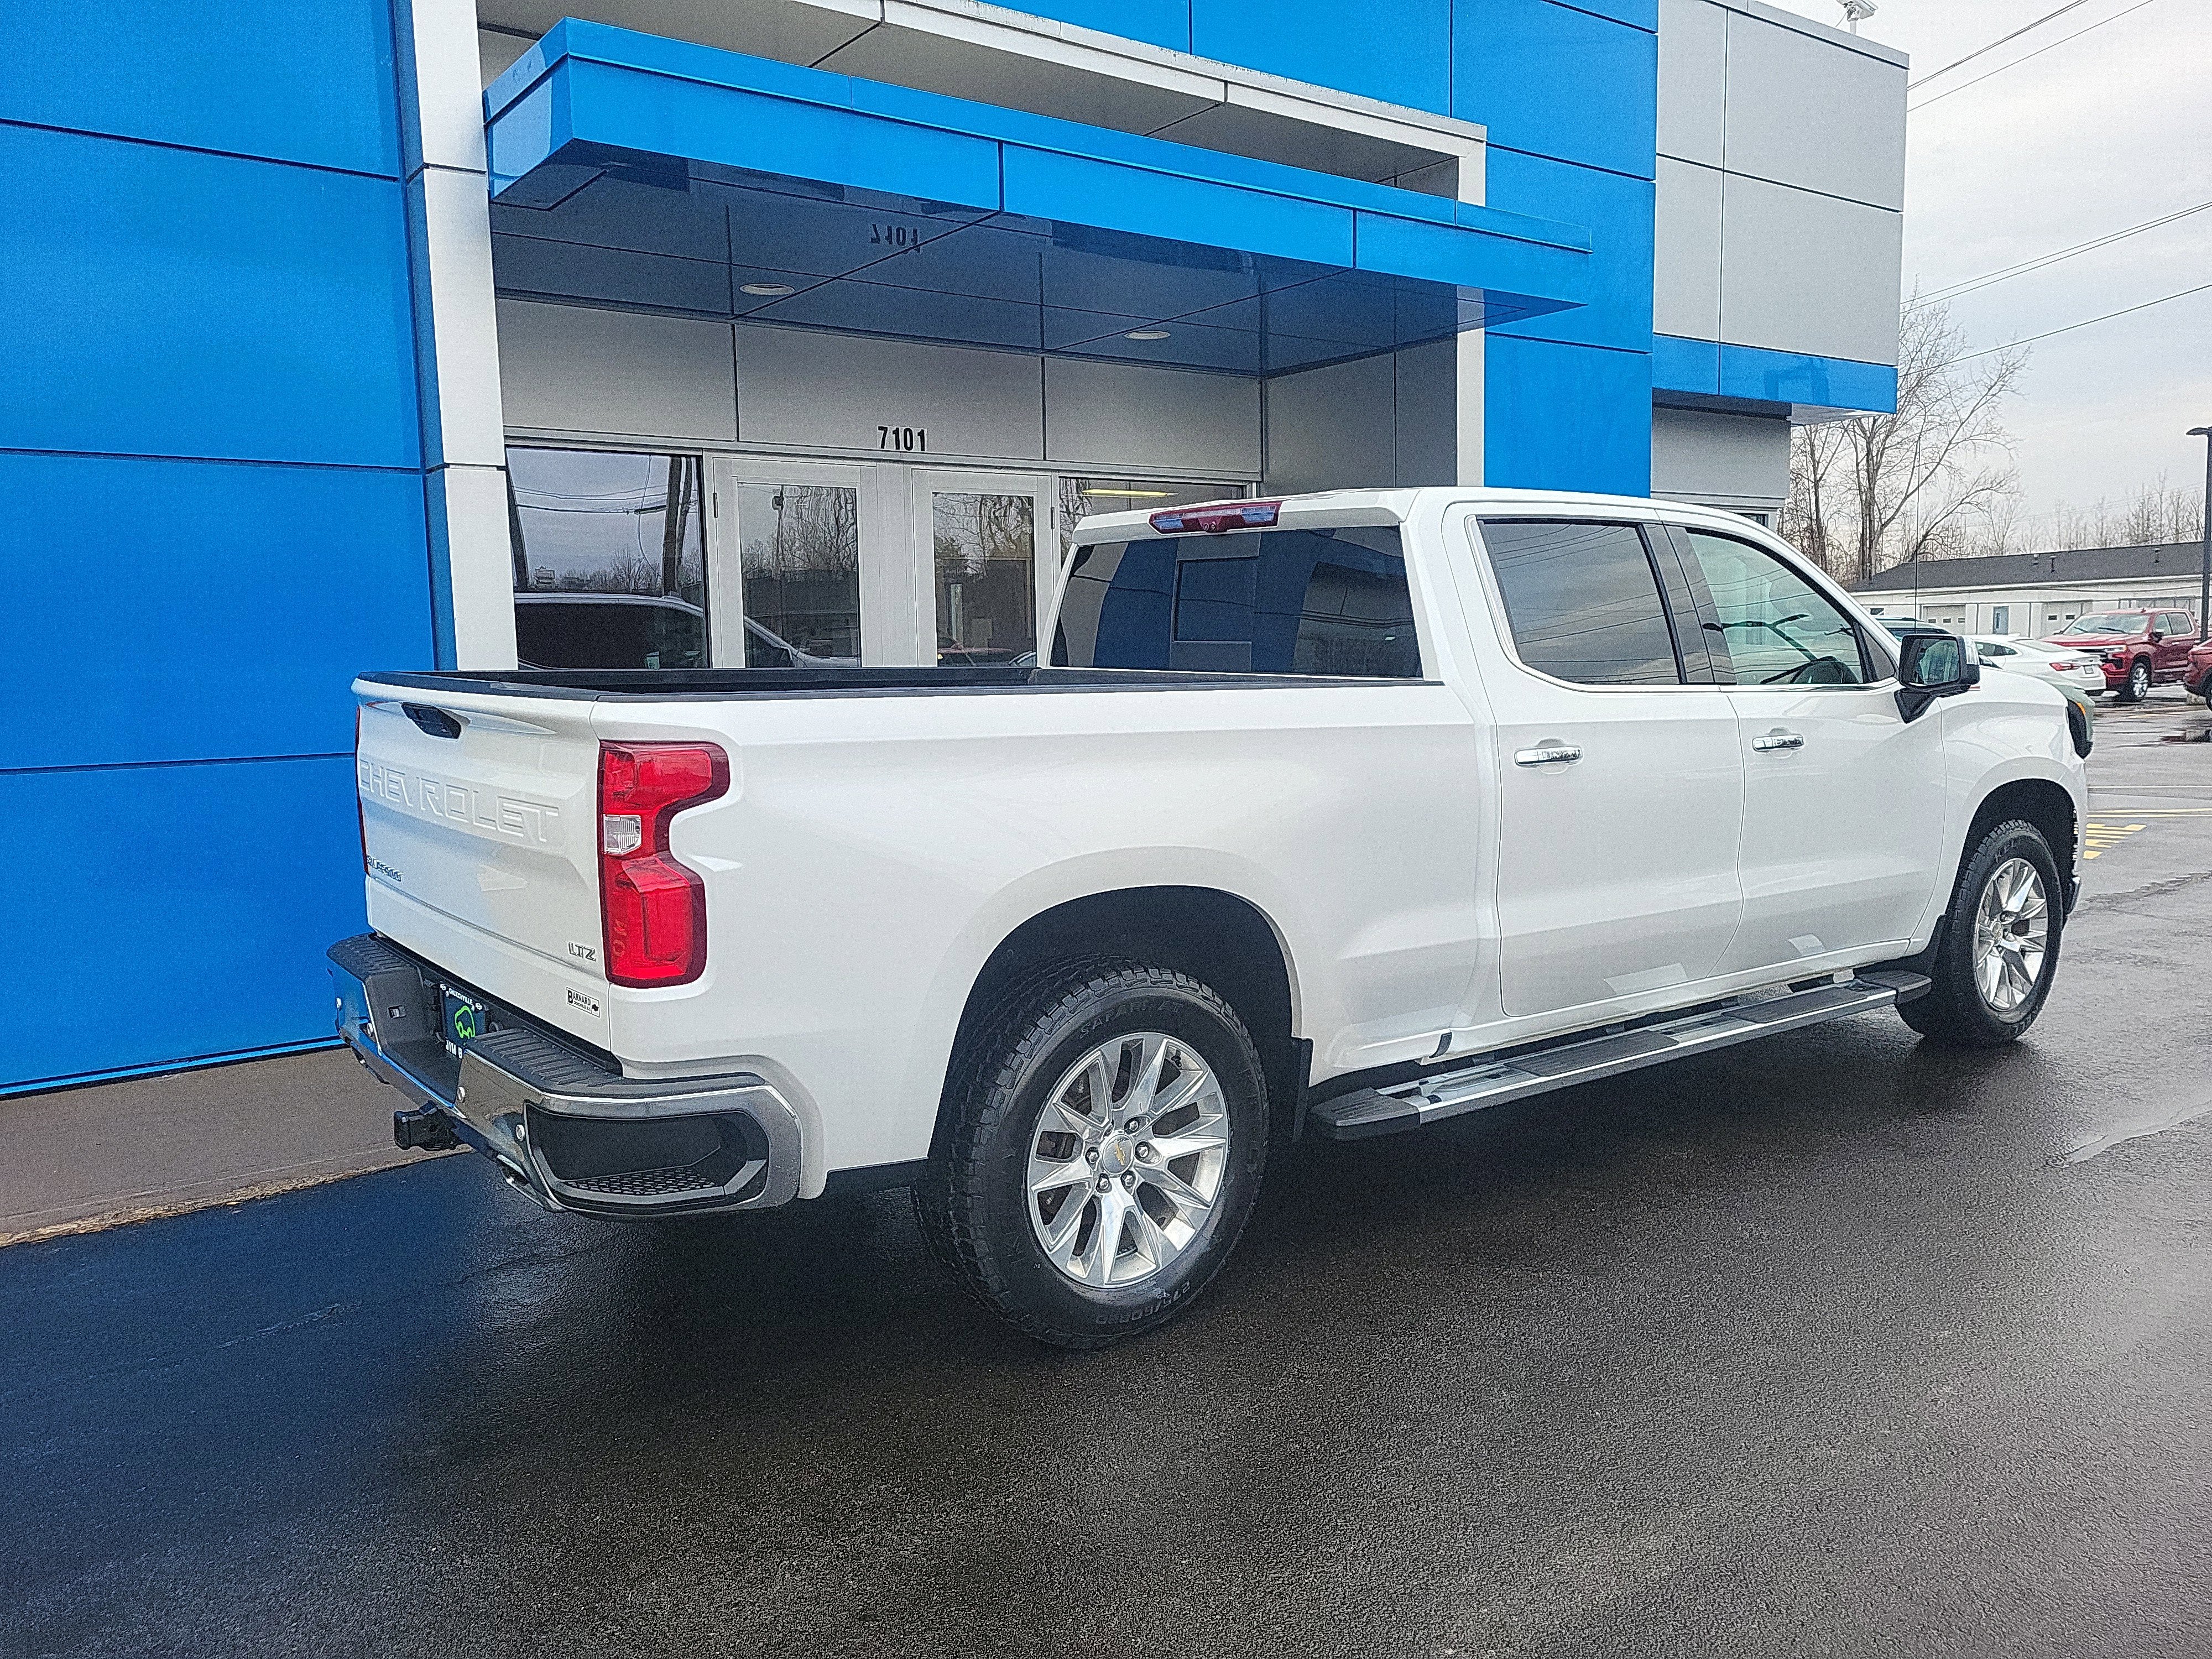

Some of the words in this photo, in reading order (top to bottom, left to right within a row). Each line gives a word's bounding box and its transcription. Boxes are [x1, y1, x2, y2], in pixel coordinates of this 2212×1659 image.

[878, 426, 925, 452] 7101
[359, 758, 559, 842] CHEVROLET
[568, 942, 597, 962] LTZ
[567, 989, 591, 1005] BARNARD
[1079, 999, 1149, 1039] SAFARI
[445, 1040, 457, 1056] JIM
